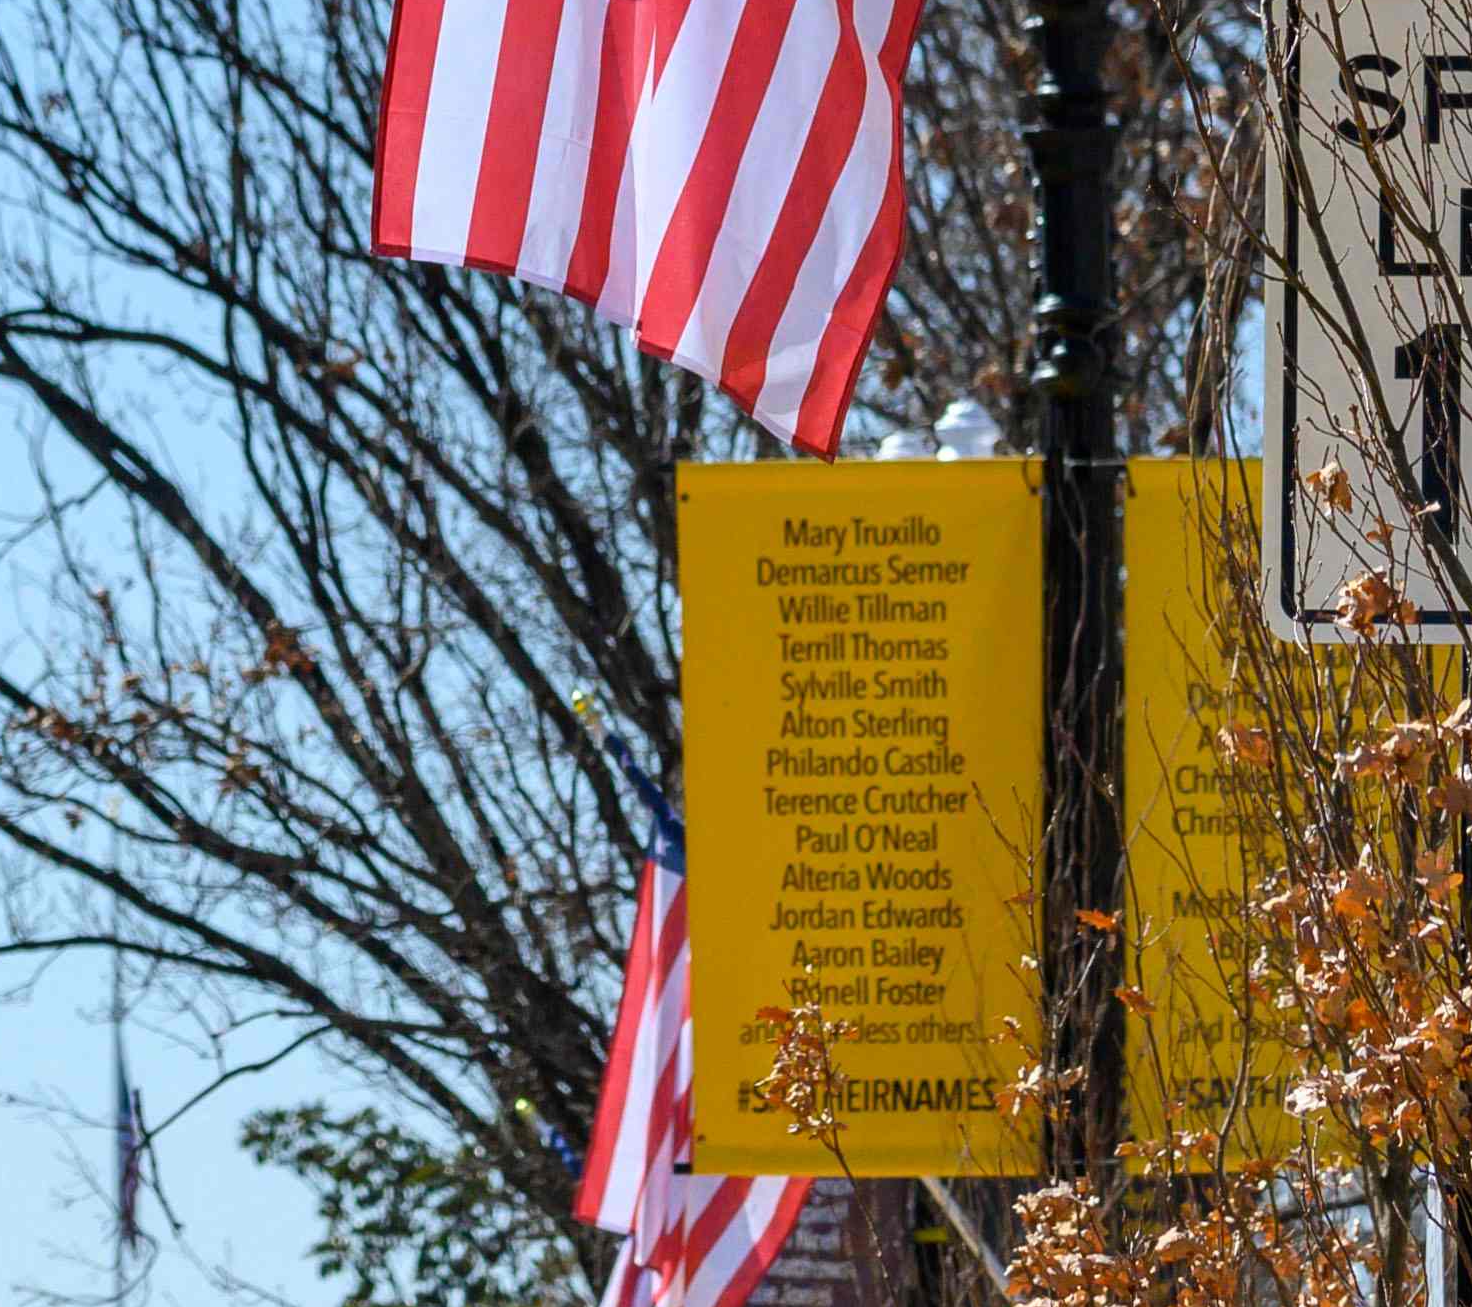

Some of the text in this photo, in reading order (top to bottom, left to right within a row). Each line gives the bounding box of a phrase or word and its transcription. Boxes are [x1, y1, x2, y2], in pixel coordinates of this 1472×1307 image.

[784, 517, 941, 556] Mary Truxillo
[757, 555, 969, 585] Demarcus Semer
[778, 594, 947, 624] Willie Tillman
[778, 631, 949, 662] Terrill Thomas
[780, 669, 947, 708] Sylville Smith
[780, 706, 950, 745] Alton Sterling
[766, 745, 966, 777] Philando Castile
[763, 784, 968, 815] Terence Crutcher
[795, 822, 939, 853] Paul O'Neal
[781, 860, 954, 892] Alteria Woods
[769, 898, 964, 931] Jordan Edwards
[791, 938, 945, 975] Aaron Bailey
[790, 976, 947, 1006] Ronell Foster
[737, 1077, 999, 1113] #SHEIRNAMES
